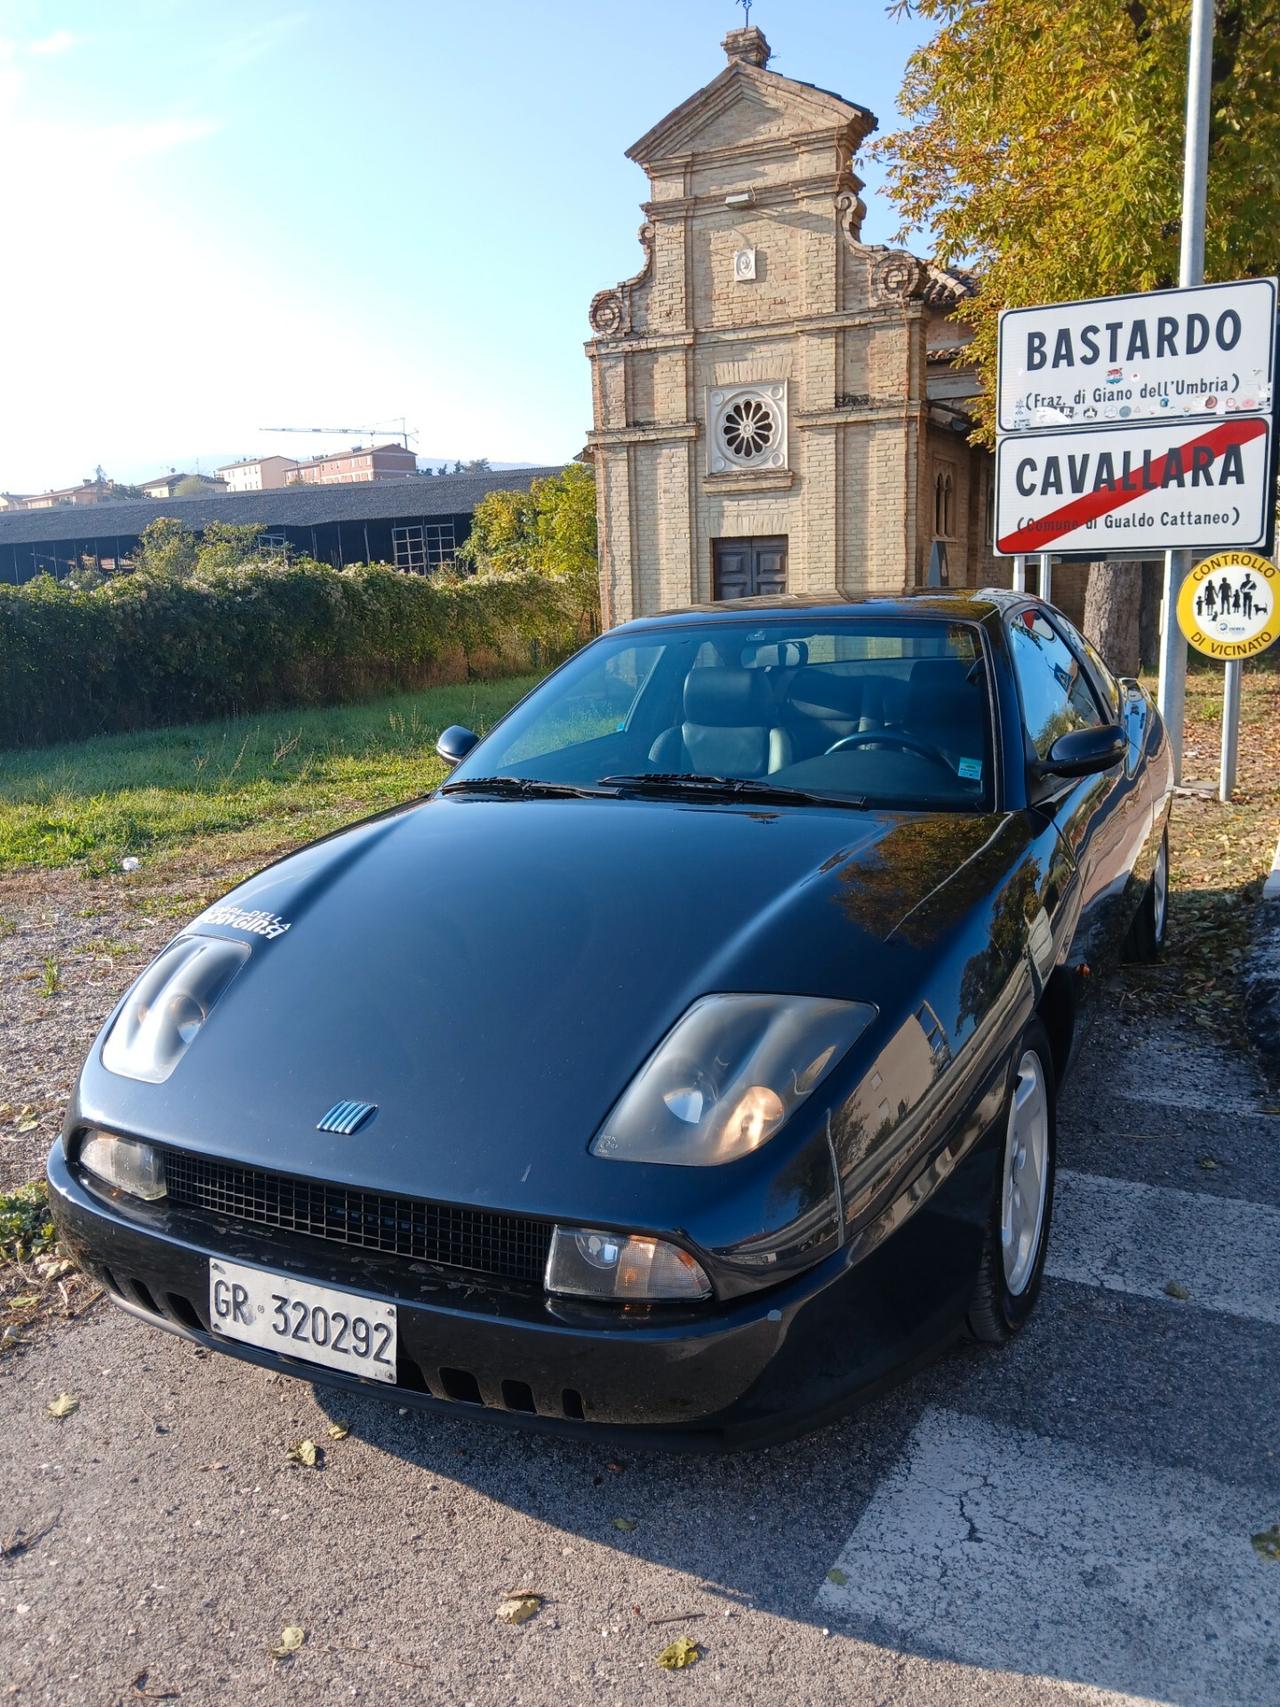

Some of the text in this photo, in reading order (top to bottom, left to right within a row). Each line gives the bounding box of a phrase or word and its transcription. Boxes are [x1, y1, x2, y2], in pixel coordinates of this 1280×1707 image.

[1026, 308, 1242, 371] BASTARDO
[1025, 373, 1240, 411] (Fraz. di Giano dell'Umbria)
[1016, 444, 1245, 497] CAVALLARA
[1017, 506, 1240, 533] (Comune di Gualdo Cattaneo)
[1192, 554, 1276, 582] CONTROLLO
[1190, 631, 1272, 656] DI VICINATO
[214, 1279, 391, 1365] GR 320292
